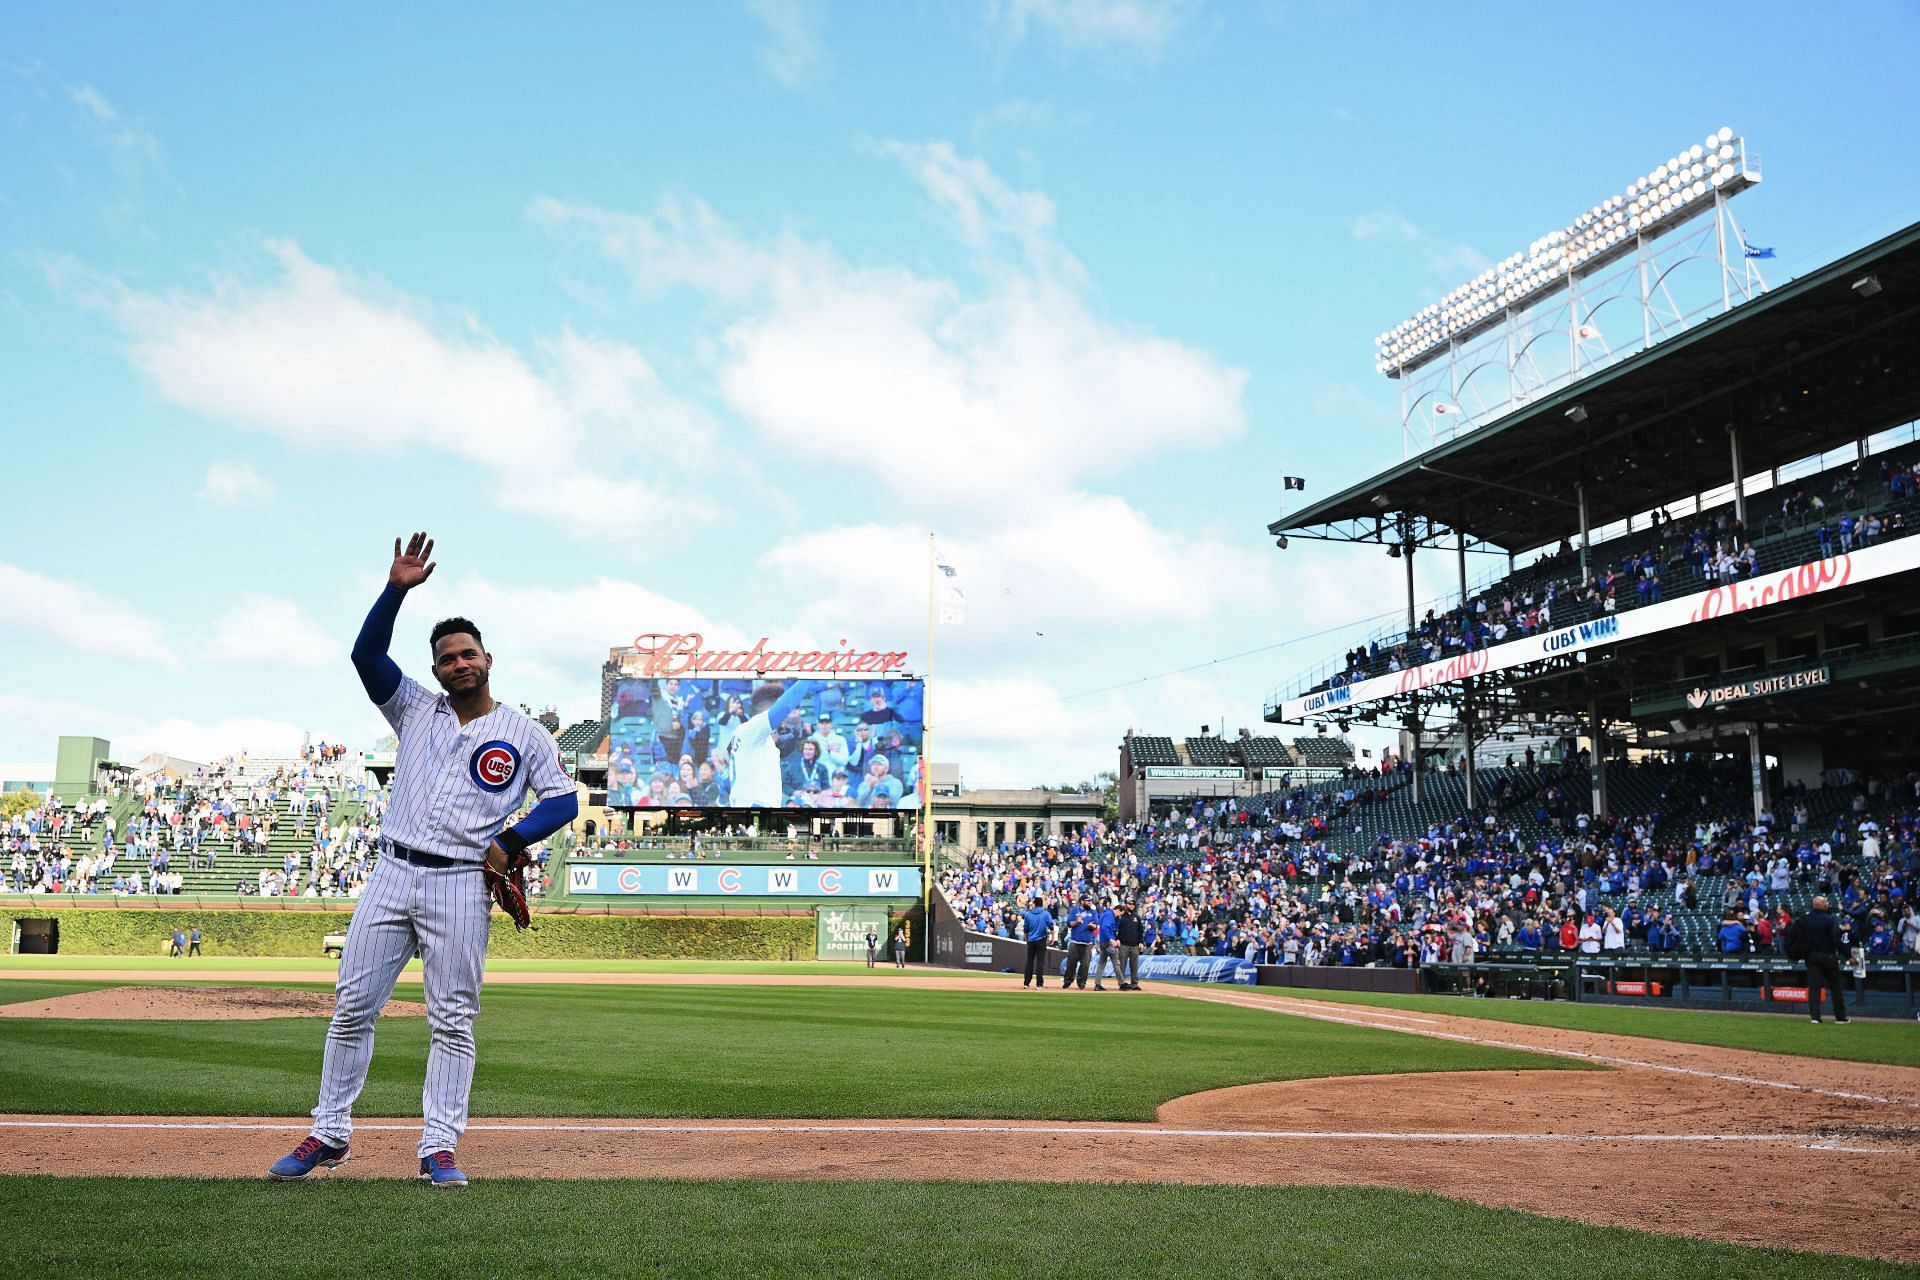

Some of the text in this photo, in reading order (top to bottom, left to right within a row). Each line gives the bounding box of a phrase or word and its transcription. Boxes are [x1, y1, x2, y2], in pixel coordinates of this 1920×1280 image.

[1543, 617, 1618, 652] CUBS WIN!
[634, 632, 908, 676] Budweiser
[1711, 669, 1827, 703] IDEAL SUITE LEVEL
[1304, 693, 1325, 711] CUBS
[1150, 768, 1240, 778] WRIGLEYROOFTOPS.COM
[574, 871, 591, 886] W
[675, 871, 692, 887] W
[775, 873, 792, 888] W
[875, 873, 892, 889] W
[827, 921, 880, 933] DRAFT
[1139, 956, 1182, 978] Reynolds
[1772, 990, 1806, 998] GATORADE
